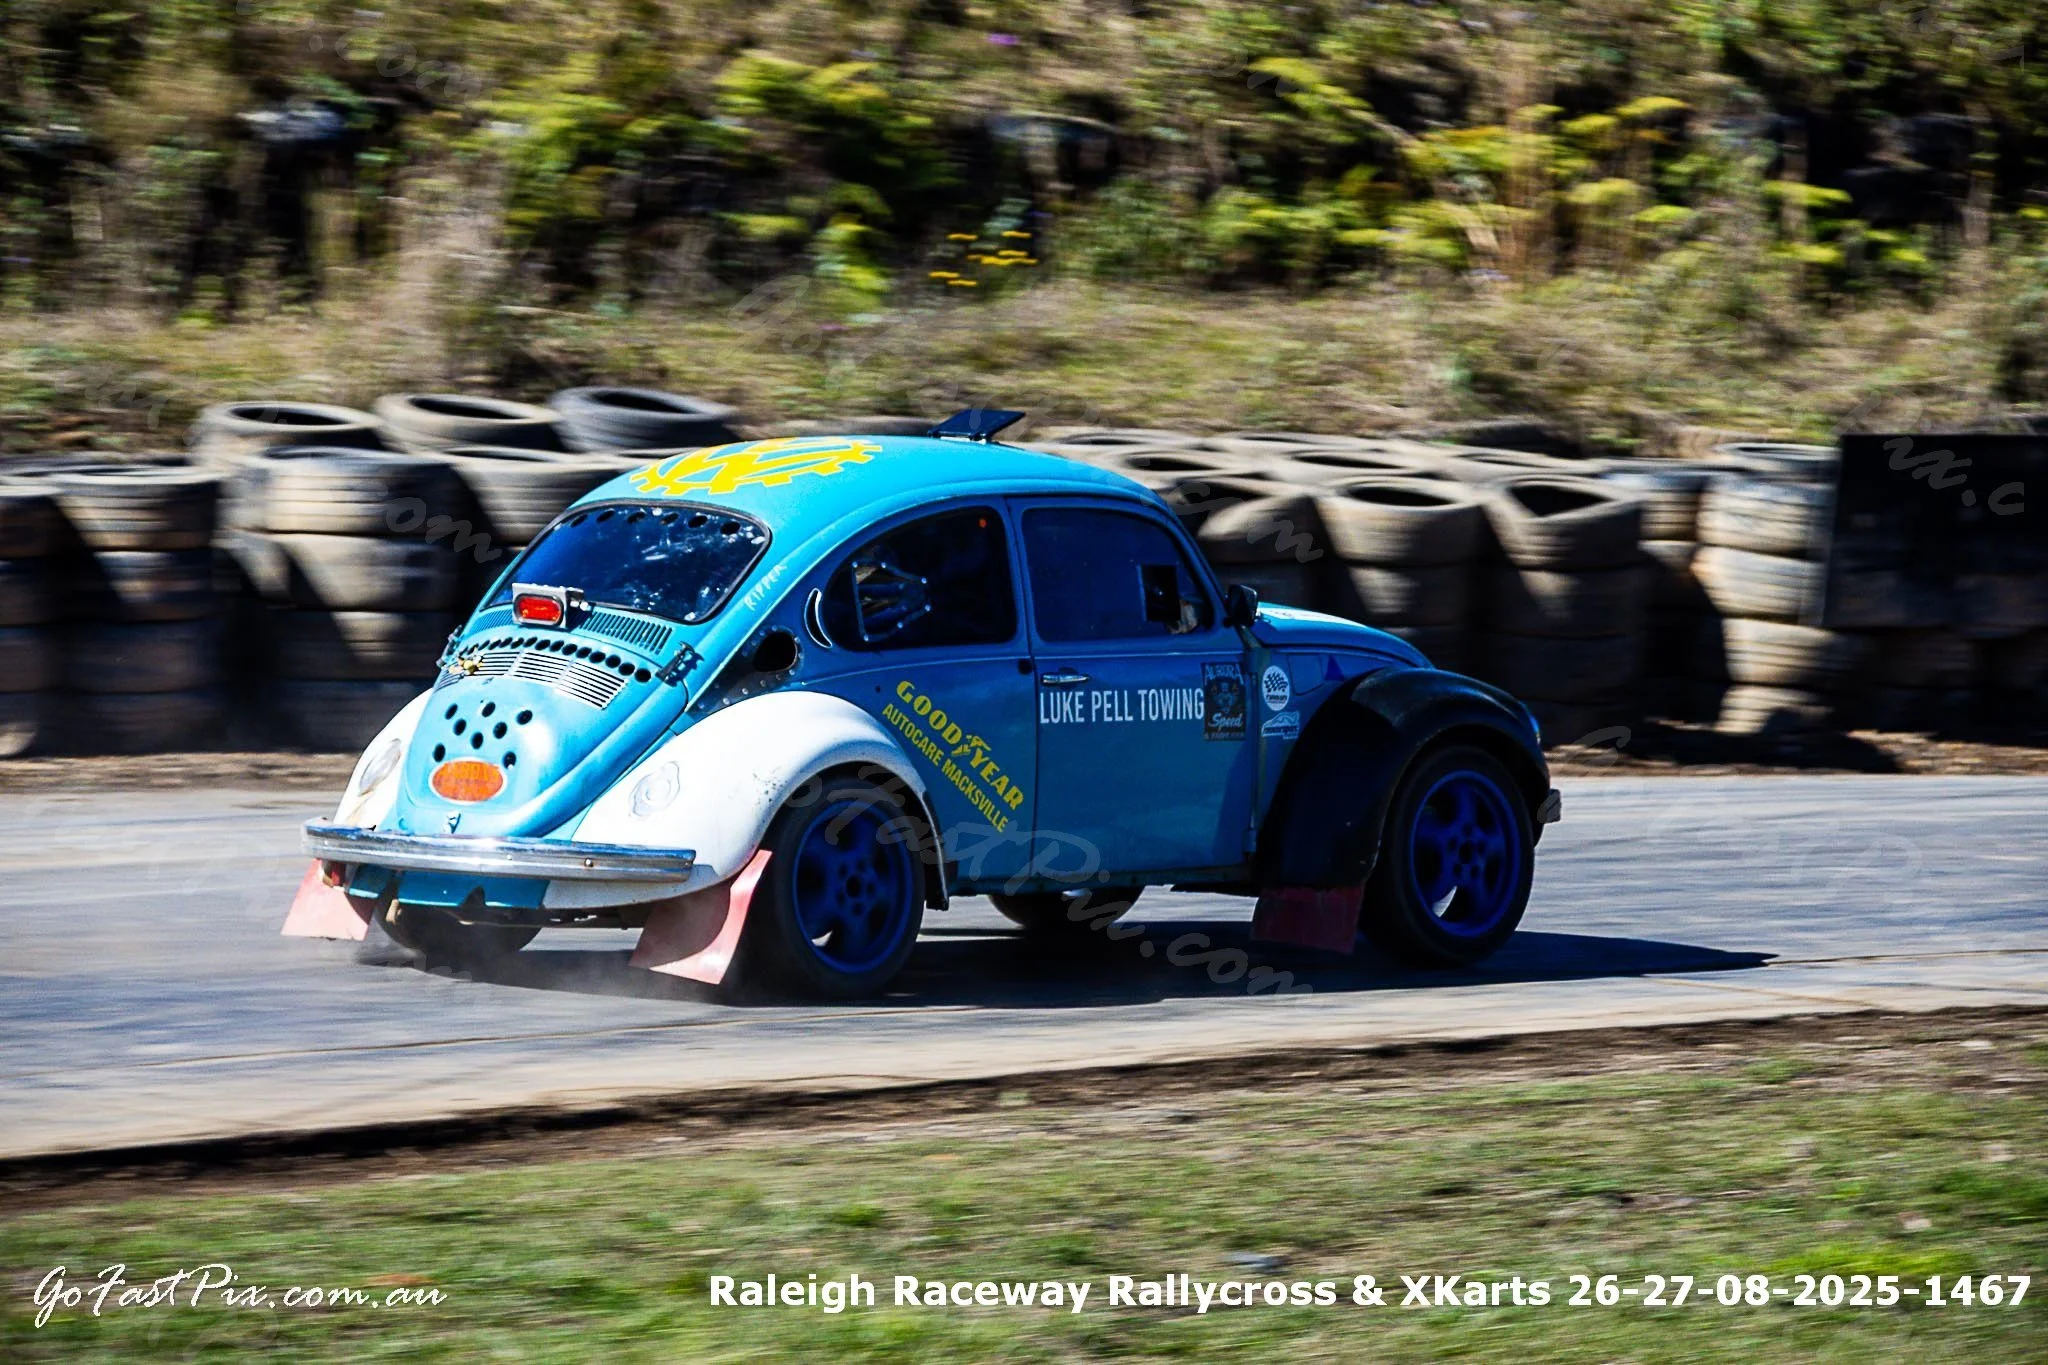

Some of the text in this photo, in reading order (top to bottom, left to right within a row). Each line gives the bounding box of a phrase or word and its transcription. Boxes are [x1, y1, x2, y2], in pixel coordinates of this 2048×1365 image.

[896, 681, 1024, 810] GOODYEAR
[1040, 687, 1205, 724] LUKE PELL TOWING
[1208, 712, 1243, 732] Speed
[882, 703, 1009, 833] AUTOCARE MACKSVILLE
